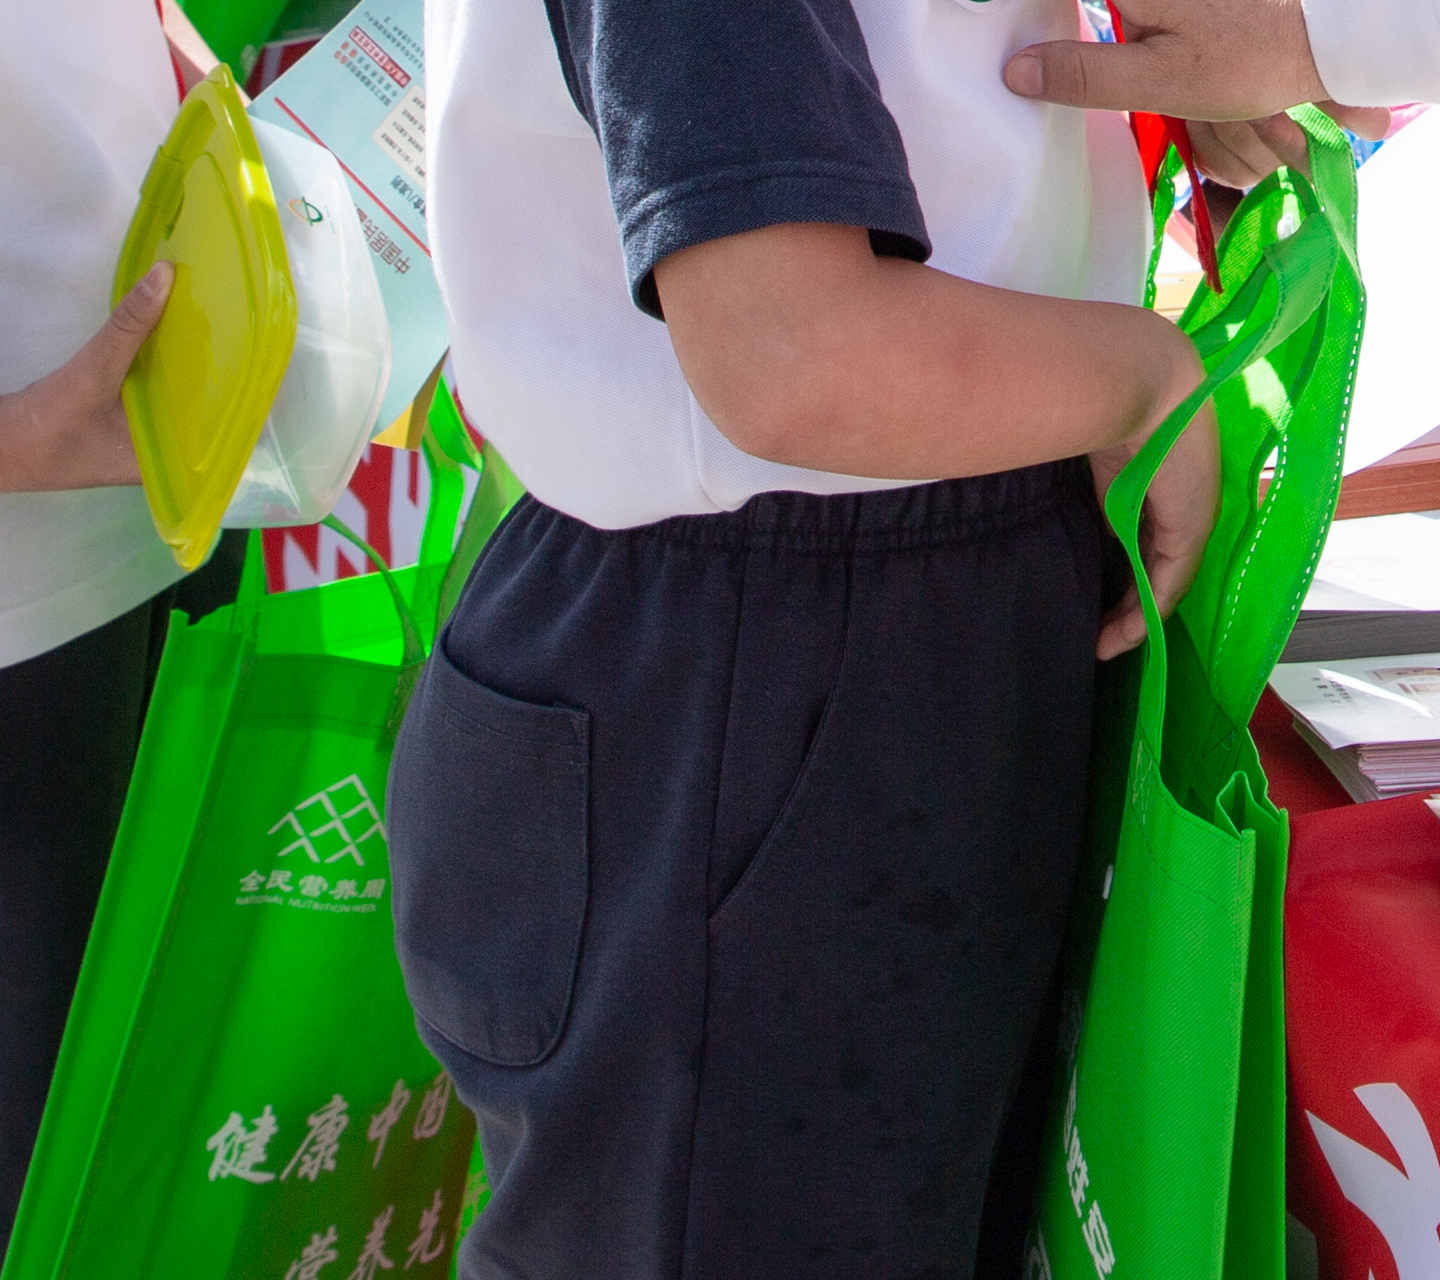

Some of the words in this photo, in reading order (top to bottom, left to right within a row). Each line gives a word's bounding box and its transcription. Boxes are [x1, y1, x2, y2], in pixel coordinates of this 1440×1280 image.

[355, 203, 410, 275] 中国居民
[239, 869, 387, 900] 全民营养周
[206, 1070, 453, 1184] 健康中国
